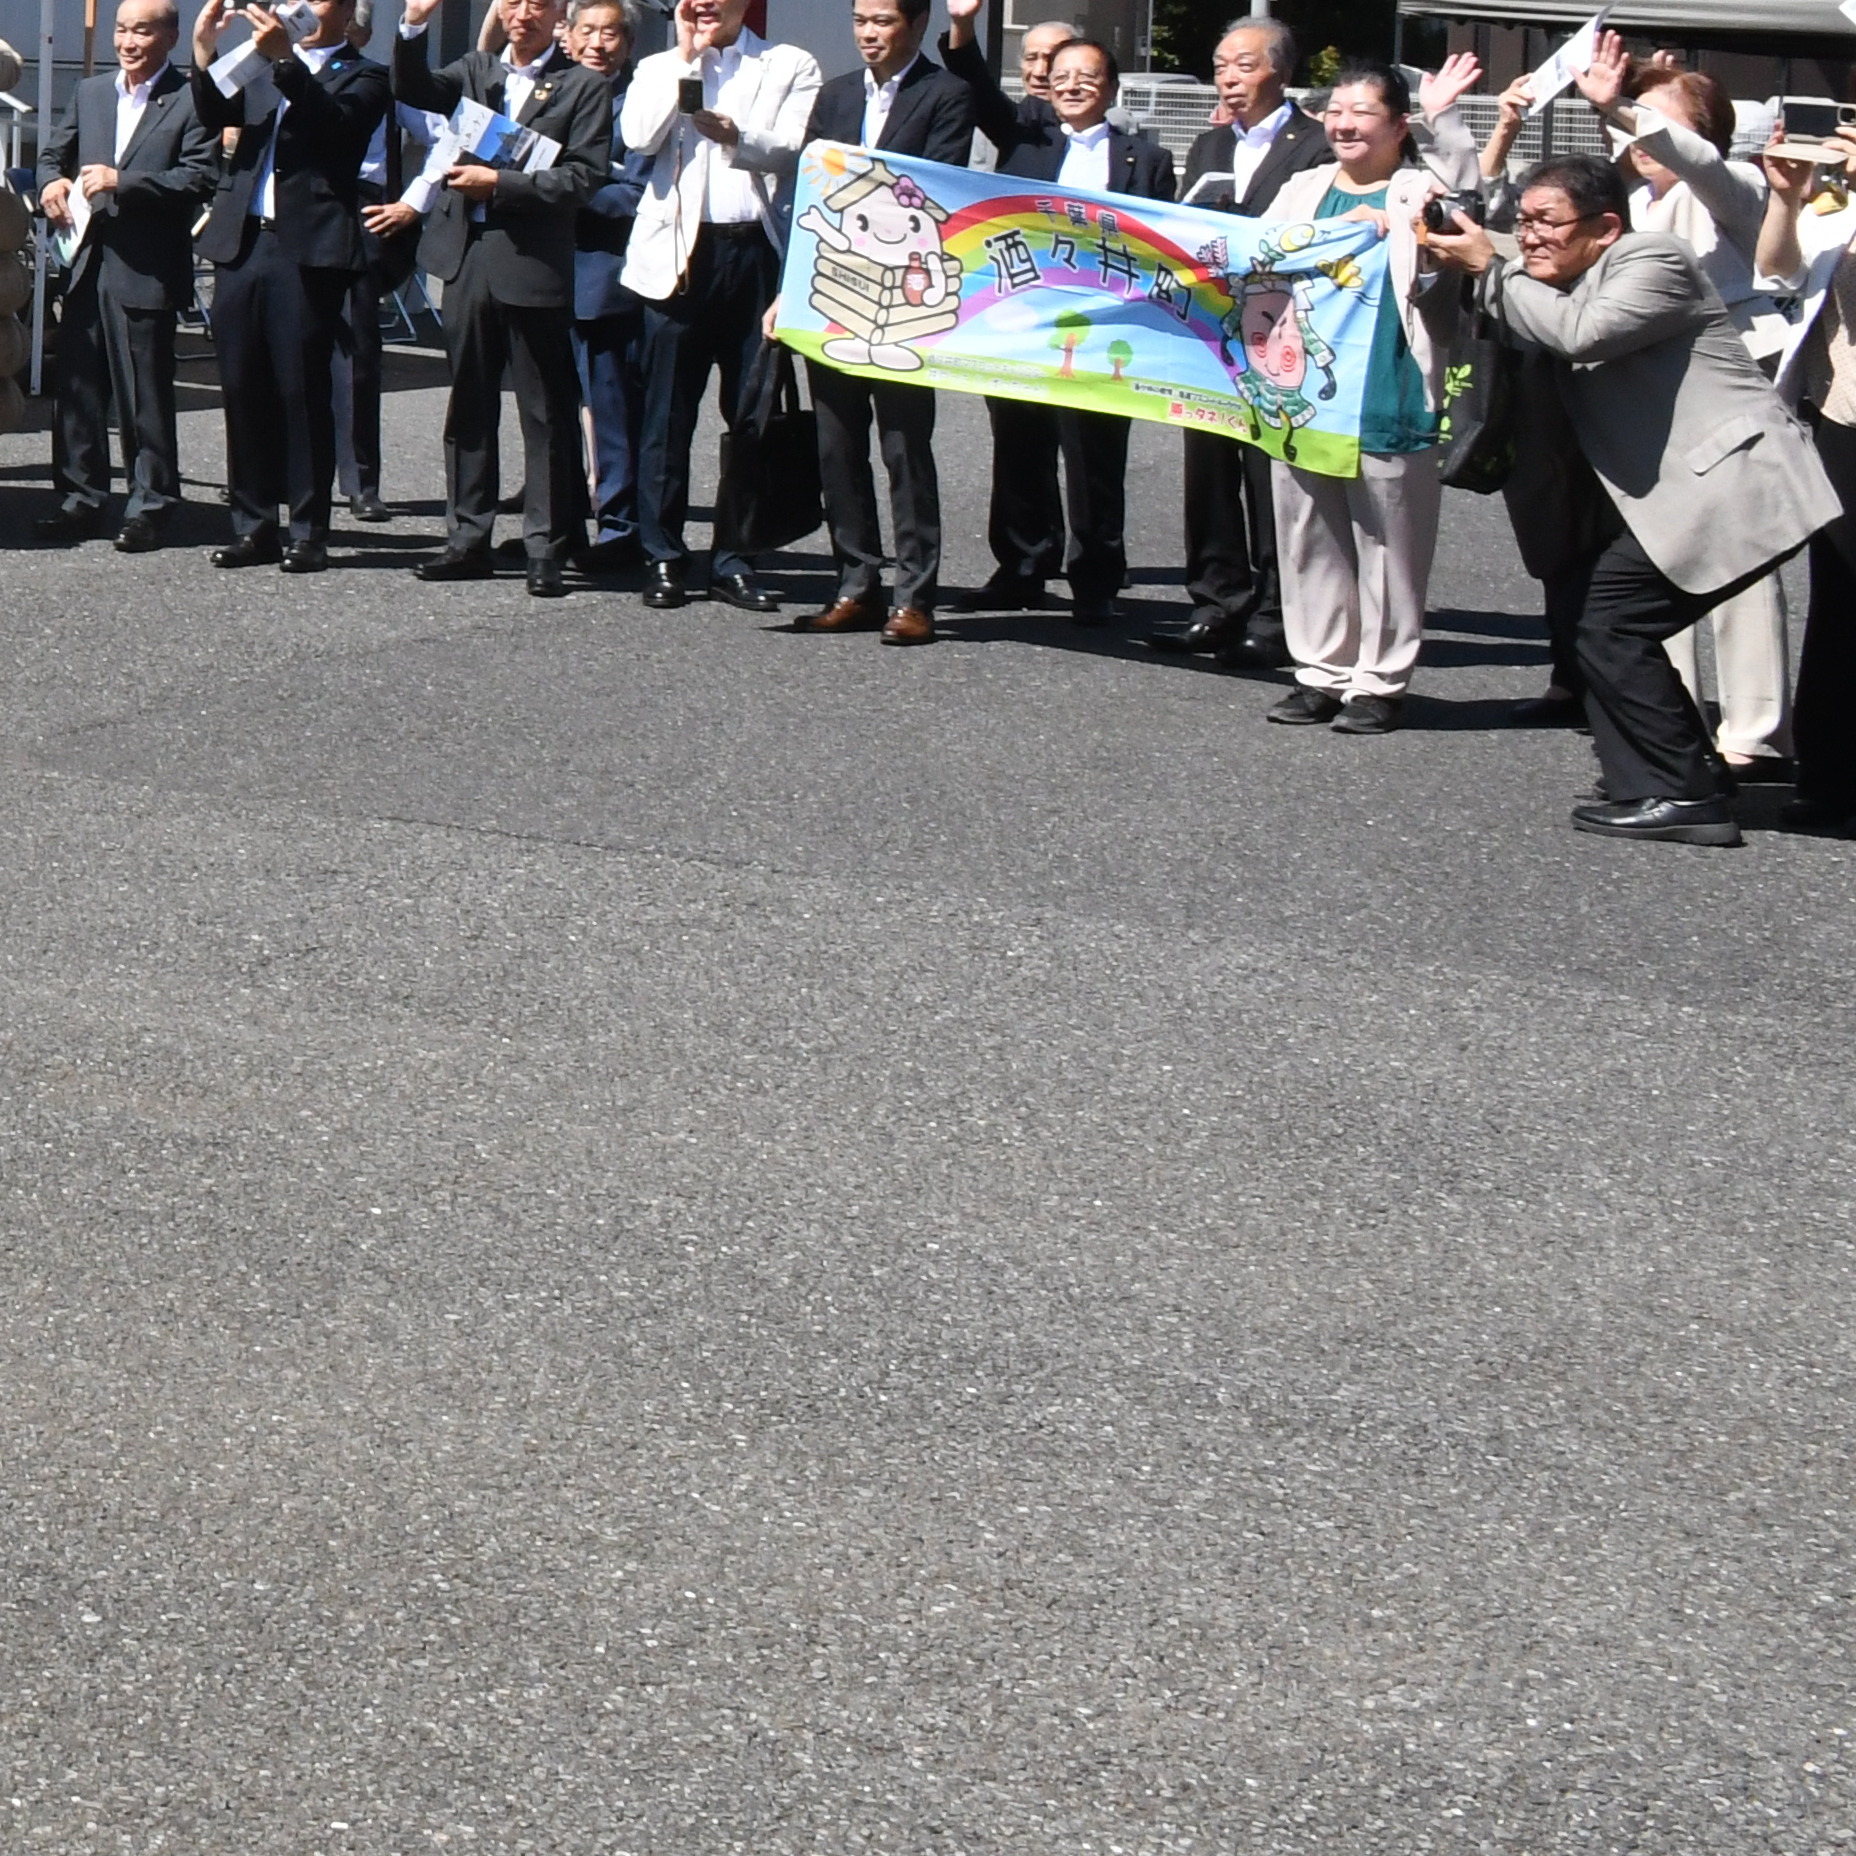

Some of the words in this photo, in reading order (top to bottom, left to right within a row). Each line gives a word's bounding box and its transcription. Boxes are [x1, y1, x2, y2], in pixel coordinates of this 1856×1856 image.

[1036, 199, 1120, 238] 千葉県
[830, 266, 870, 293] SHISUI
[984, 227, 1193, 323] 酒々井町
